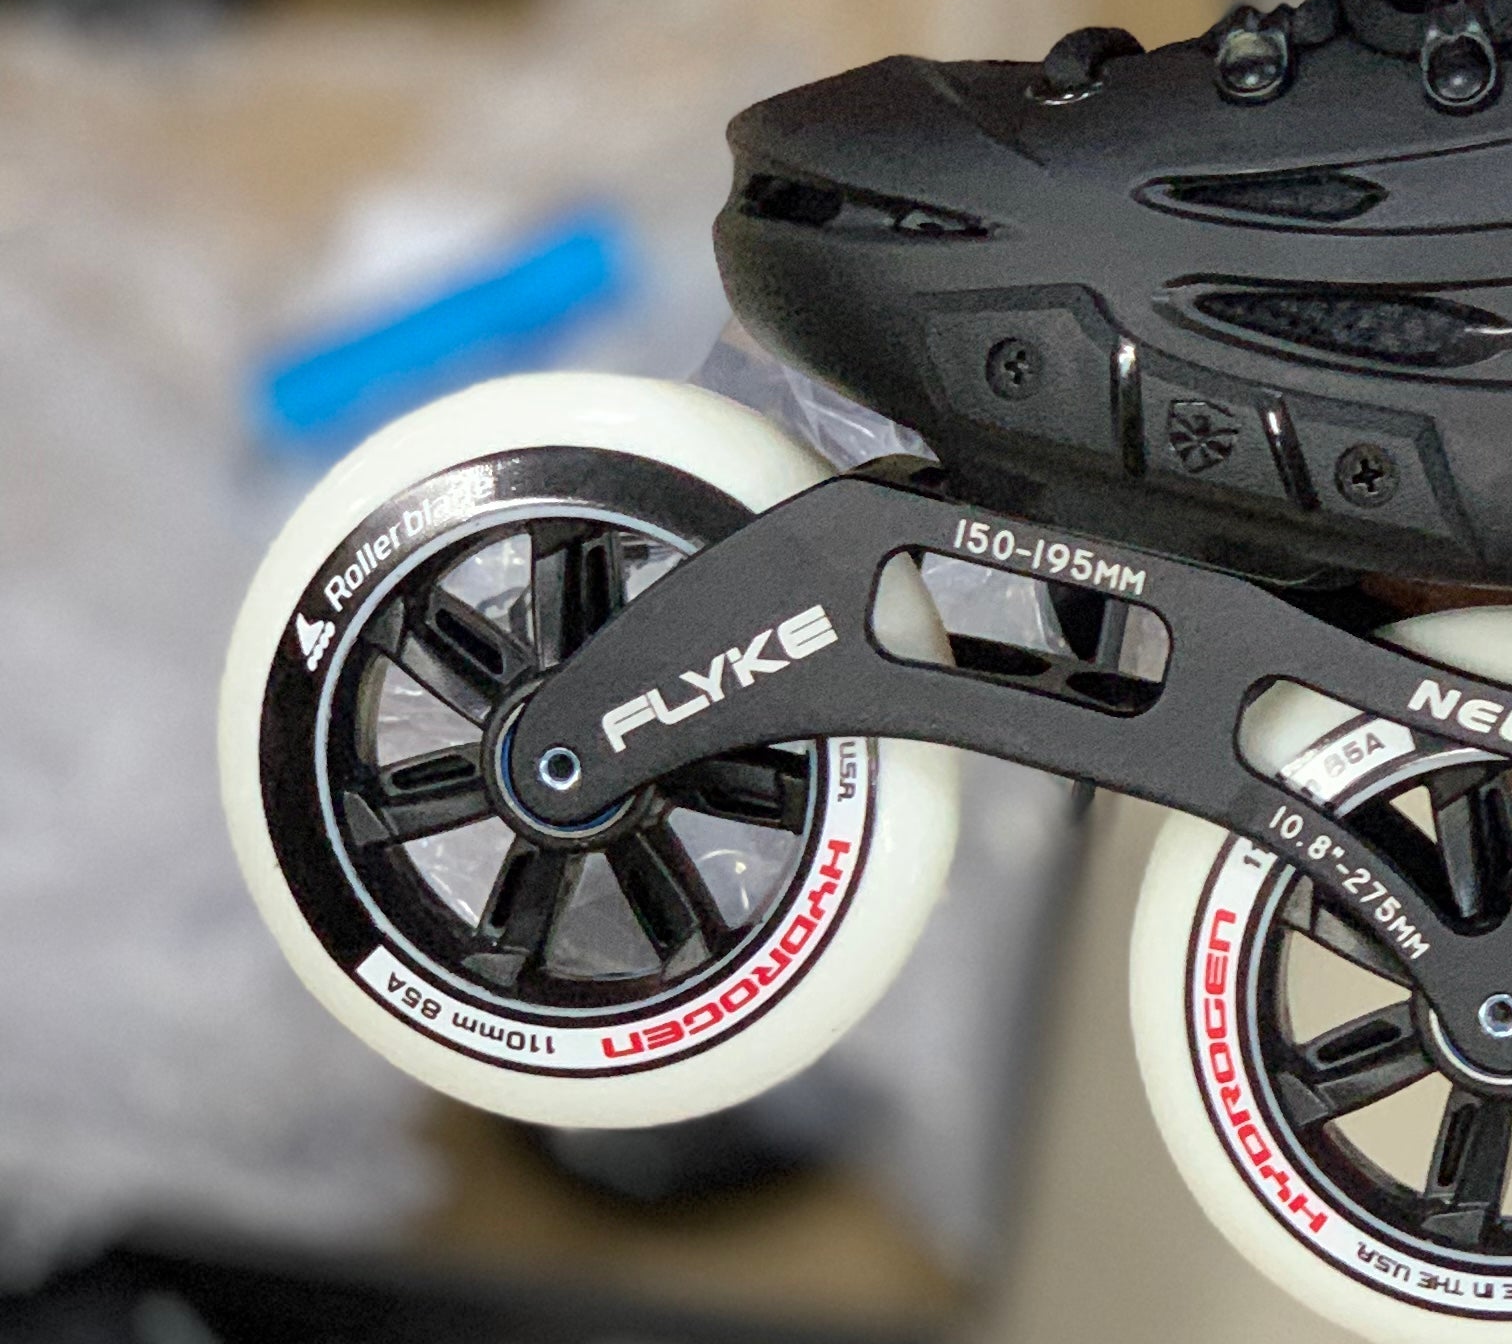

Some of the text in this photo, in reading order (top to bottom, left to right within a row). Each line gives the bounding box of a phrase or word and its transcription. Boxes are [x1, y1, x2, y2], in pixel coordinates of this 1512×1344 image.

[953, 519, 1147, 595] 150-195MM
[602, 604, 839, 753] FLYKE
[602, 839, 852, 1059] HYDROGEN
[387, 971, 555, 1054] 110mm 85A
[1204, 908, 1328, 1234] HYDROGEN
[1417, 1271, 1464, 1296] THE
